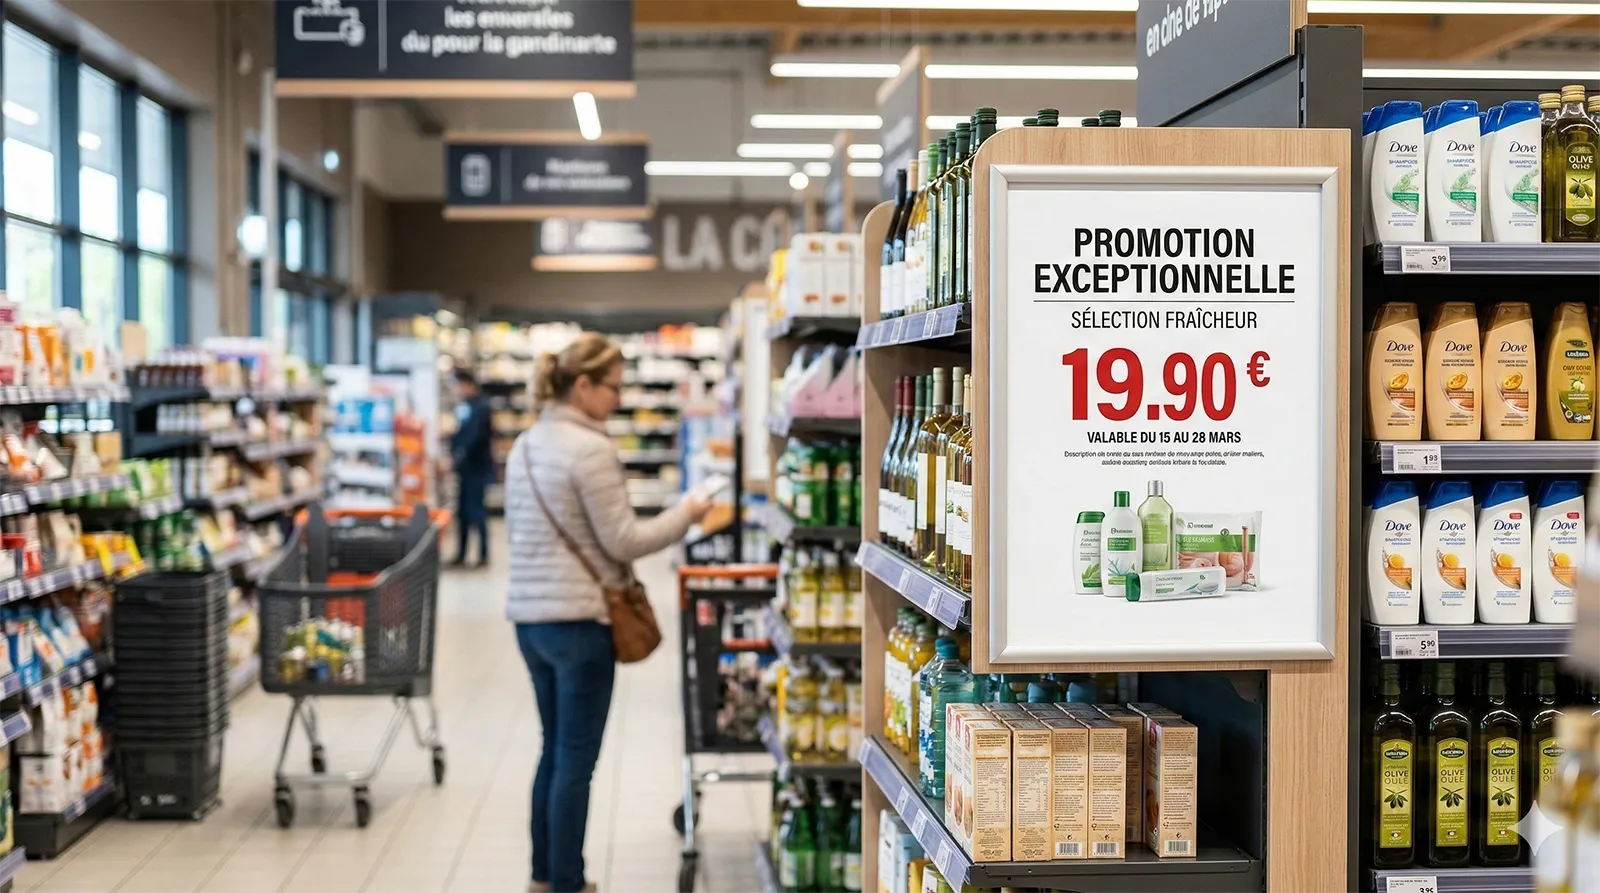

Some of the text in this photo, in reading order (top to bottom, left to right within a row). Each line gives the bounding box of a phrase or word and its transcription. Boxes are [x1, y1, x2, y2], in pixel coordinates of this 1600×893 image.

[1389, 140, 1418, 153] Dove
[1447, 139, 1475, 152] Dove
[1509, 141, 1537, 153] Dove
[1568, 155, 1594, 164] OLIVE
[663, 214, 724, 272] LA
[1074, 227, 1255, 259] PROMOTION
[1034, 263, 1296, 294] EXCEPTIONNELLE
[1071, 307, 1258, 329] SÉLECTION FRAÎCHEUR
[1386, 340, 1415, 352] Dove
[1444, 340, 1473, 352] Dove
[1499, 340, 1528, 353] Dove
[1062, 347, 1271, 422] 19.90 €
[1087, 431, 1242, 444] VALABLE DU 15 AU 28 MARS
[1384, 519, 1412, 531] Dove
[1439, 519, 1467, 531] Dove
[1493, 519, 1521, 531] Dove
[1550, 518, 1578, 530] Dove
[1384, 770, 1409, 778] OLIVE
[1440, 769, 1465, 777] OLIVE
[1491, 768, 1516, 776] OLIVE
